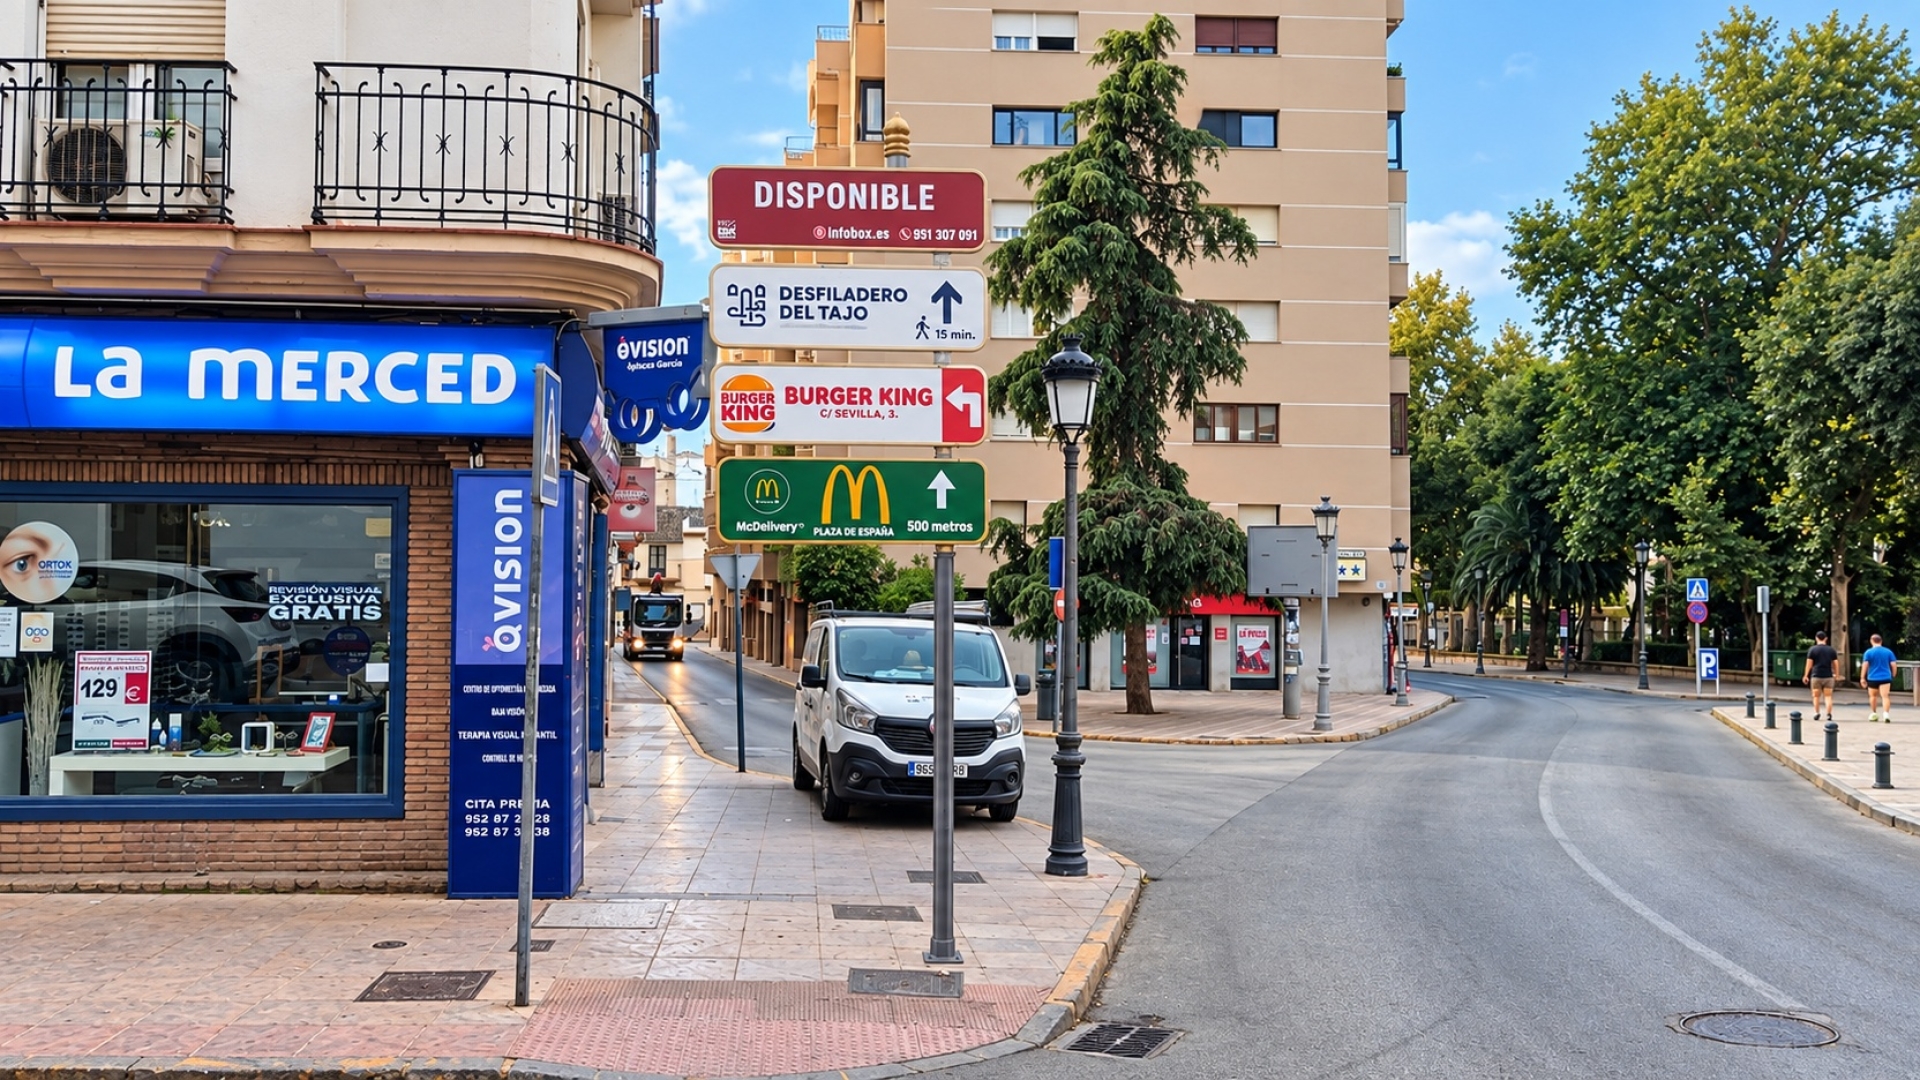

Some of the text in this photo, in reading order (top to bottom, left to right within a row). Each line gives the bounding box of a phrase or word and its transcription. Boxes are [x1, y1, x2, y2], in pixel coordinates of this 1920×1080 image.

[754, 181, 935, 211] DISPONIBLE
[913, 229, 933, 240] 951
[935, 229, 956, 241] 307
[958, 229, 978, 241] 091
[779, 286, 908, 303] DESFILADERO
[779, 304, 869, 321] DEL TAJO
[935, 329, 976, 340] 15 min.
[720, 392, 775, 405] BURGER
[784, 386, 934, 406] BURGER KING
[720, 404, 775, 421] KING
[820, 409, 899, 420] C/ SEVILLA, 3.
[813, 526, 895, 537] PLAZA DE ESPAÑA
[907, 520, 974, 532] 500 metros
[269, 585, 382, 594] REVISIÓN VISUAL
[269, 594, 381, 604] EXCLUSIVA
[268, 605, 382, 620] GRATIS
[80, 678, 118, 698] 129
[458, 731, 491, 739] TERAPIA
[464, 799, 551, 809] CITA PREIA
[464, 814, 489, 824] 952
[493, 814, 509, 824] 87
[534, 814, 550, 823] 28
[464, 827, 489, 837] 952
[493, 827, 509, 837] 87
[534, 827, 550, 837] 38
